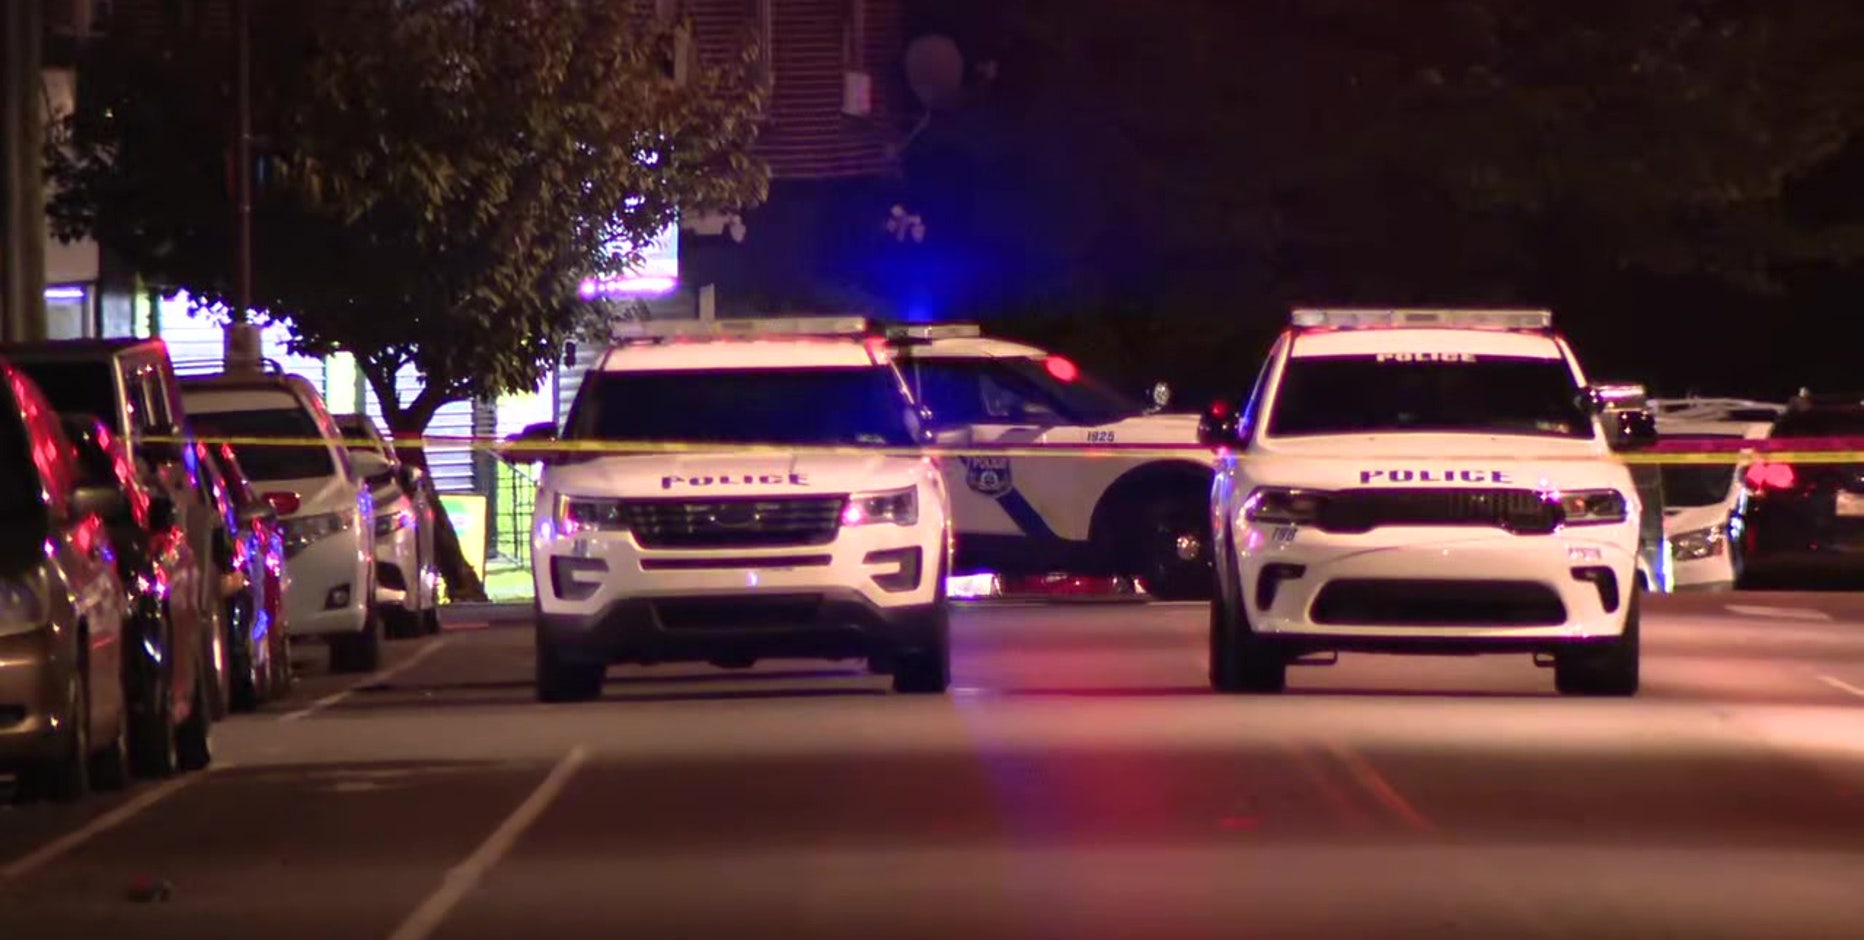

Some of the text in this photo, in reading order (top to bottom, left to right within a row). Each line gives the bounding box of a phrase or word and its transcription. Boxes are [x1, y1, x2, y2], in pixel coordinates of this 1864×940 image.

[1376, 352, 1476, 362] POLICE
[661, 473, 811, 490] POLICE
[1360, 470, 1513, 484] POLICE
